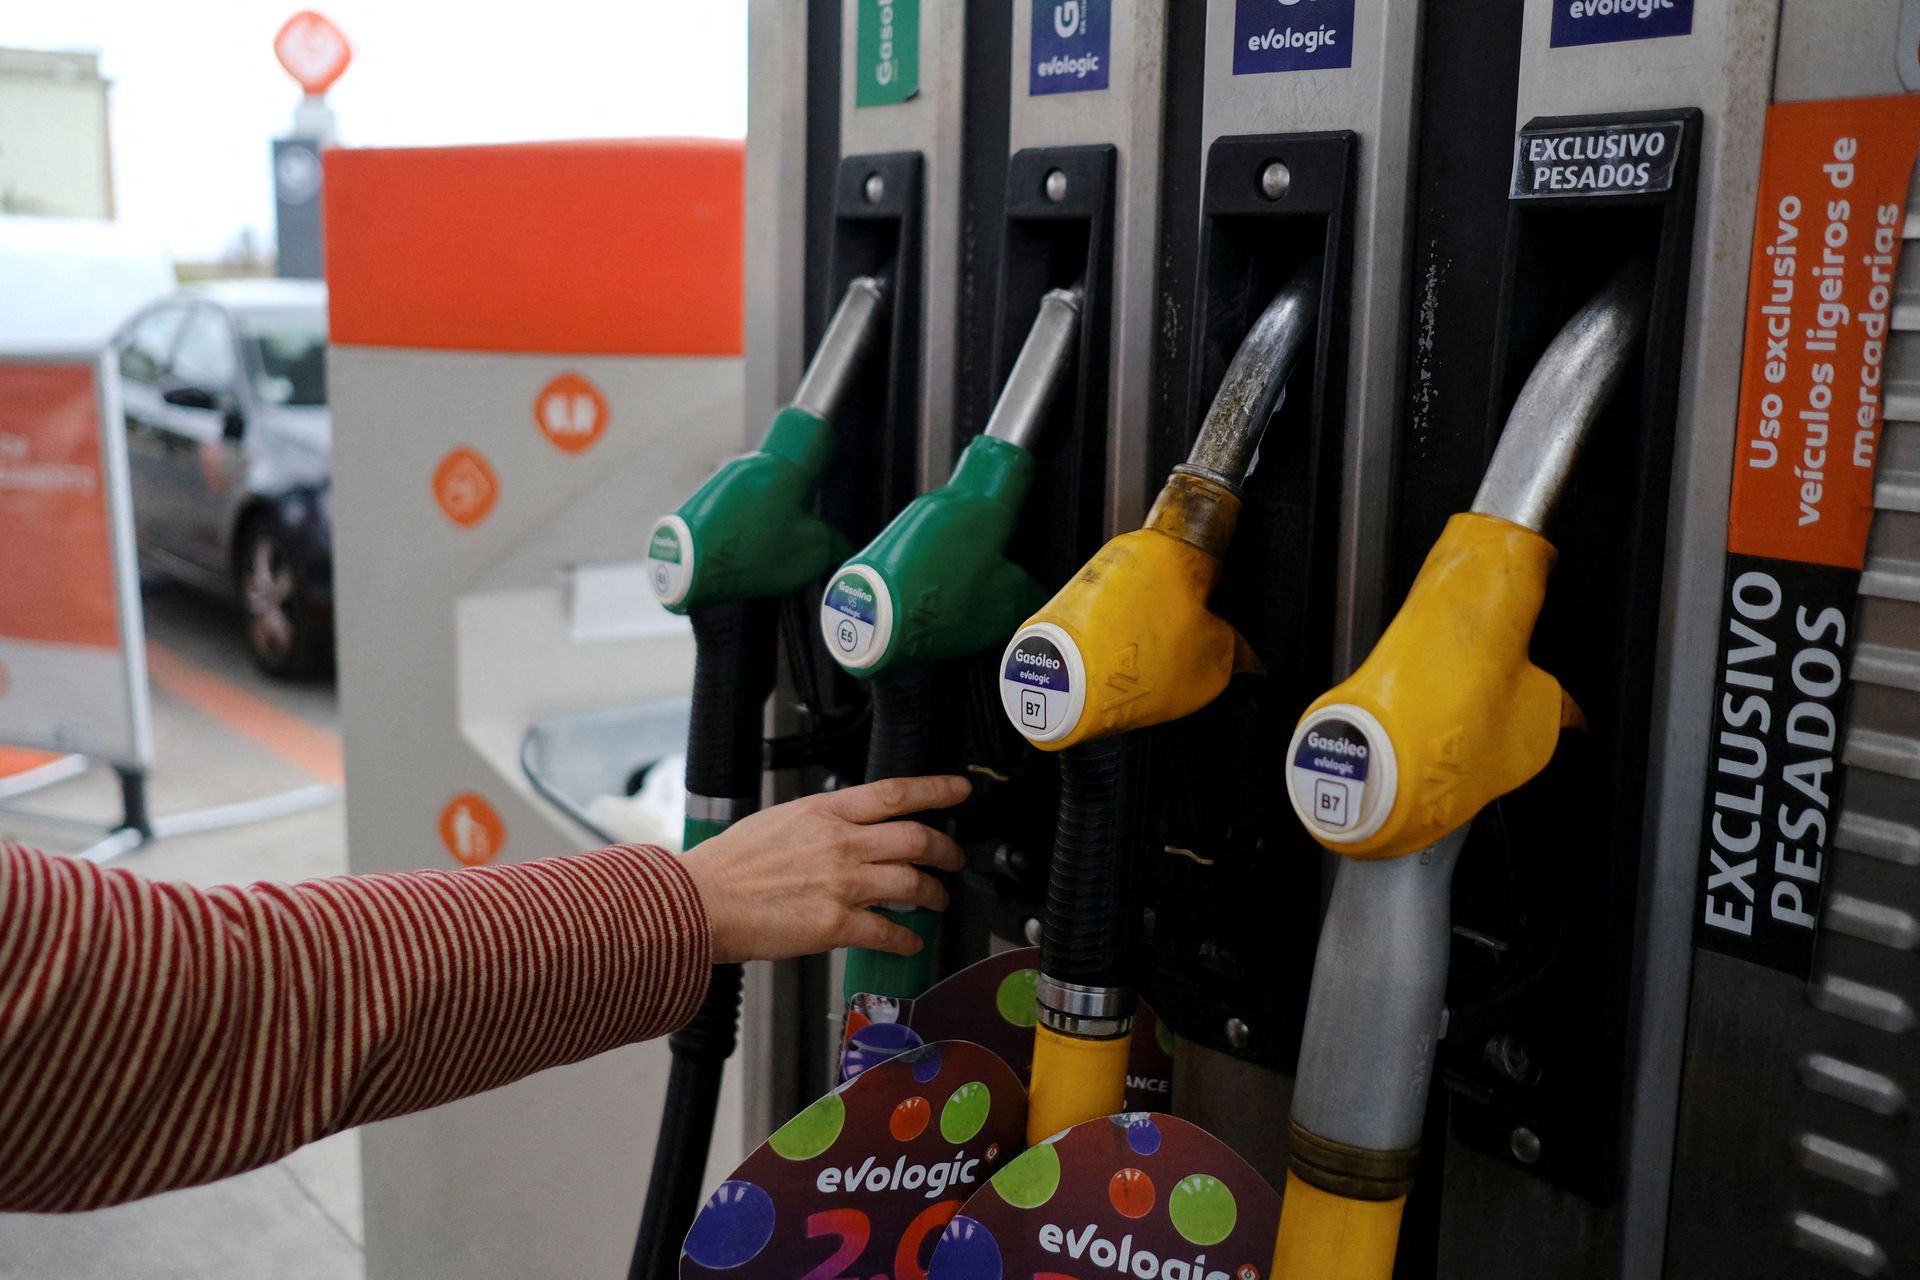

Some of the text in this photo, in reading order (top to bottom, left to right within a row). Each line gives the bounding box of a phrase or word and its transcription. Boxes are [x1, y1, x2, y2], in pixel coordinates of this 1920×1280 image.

[1529, 132, 1665, 161] EXCLUSIVO
[1533, 162, 1650, 190] PESADOS
[1749, 195, 1802, 468] Uso exclusivo
[1794, 136, 1857, 526] veículos ligeiros de
[1853, 204, 1899, 468] mercadorias
[839, 580, 873, 602] Gasolina
[841, 628, 853, 643] E5
[1015, 648, 1061, 670] Gasóleo
[1026, 701, 1041, 717] B7
[1308, 731, 1367, 758] Gasóleo
[1704, 571, 1783, 937] EXCLUSIVO
[1770, 604, 1846, 931] PESADOS
[1321, 793, 1340, 811] B7
[816, 1150, 980, 1199] evologic
